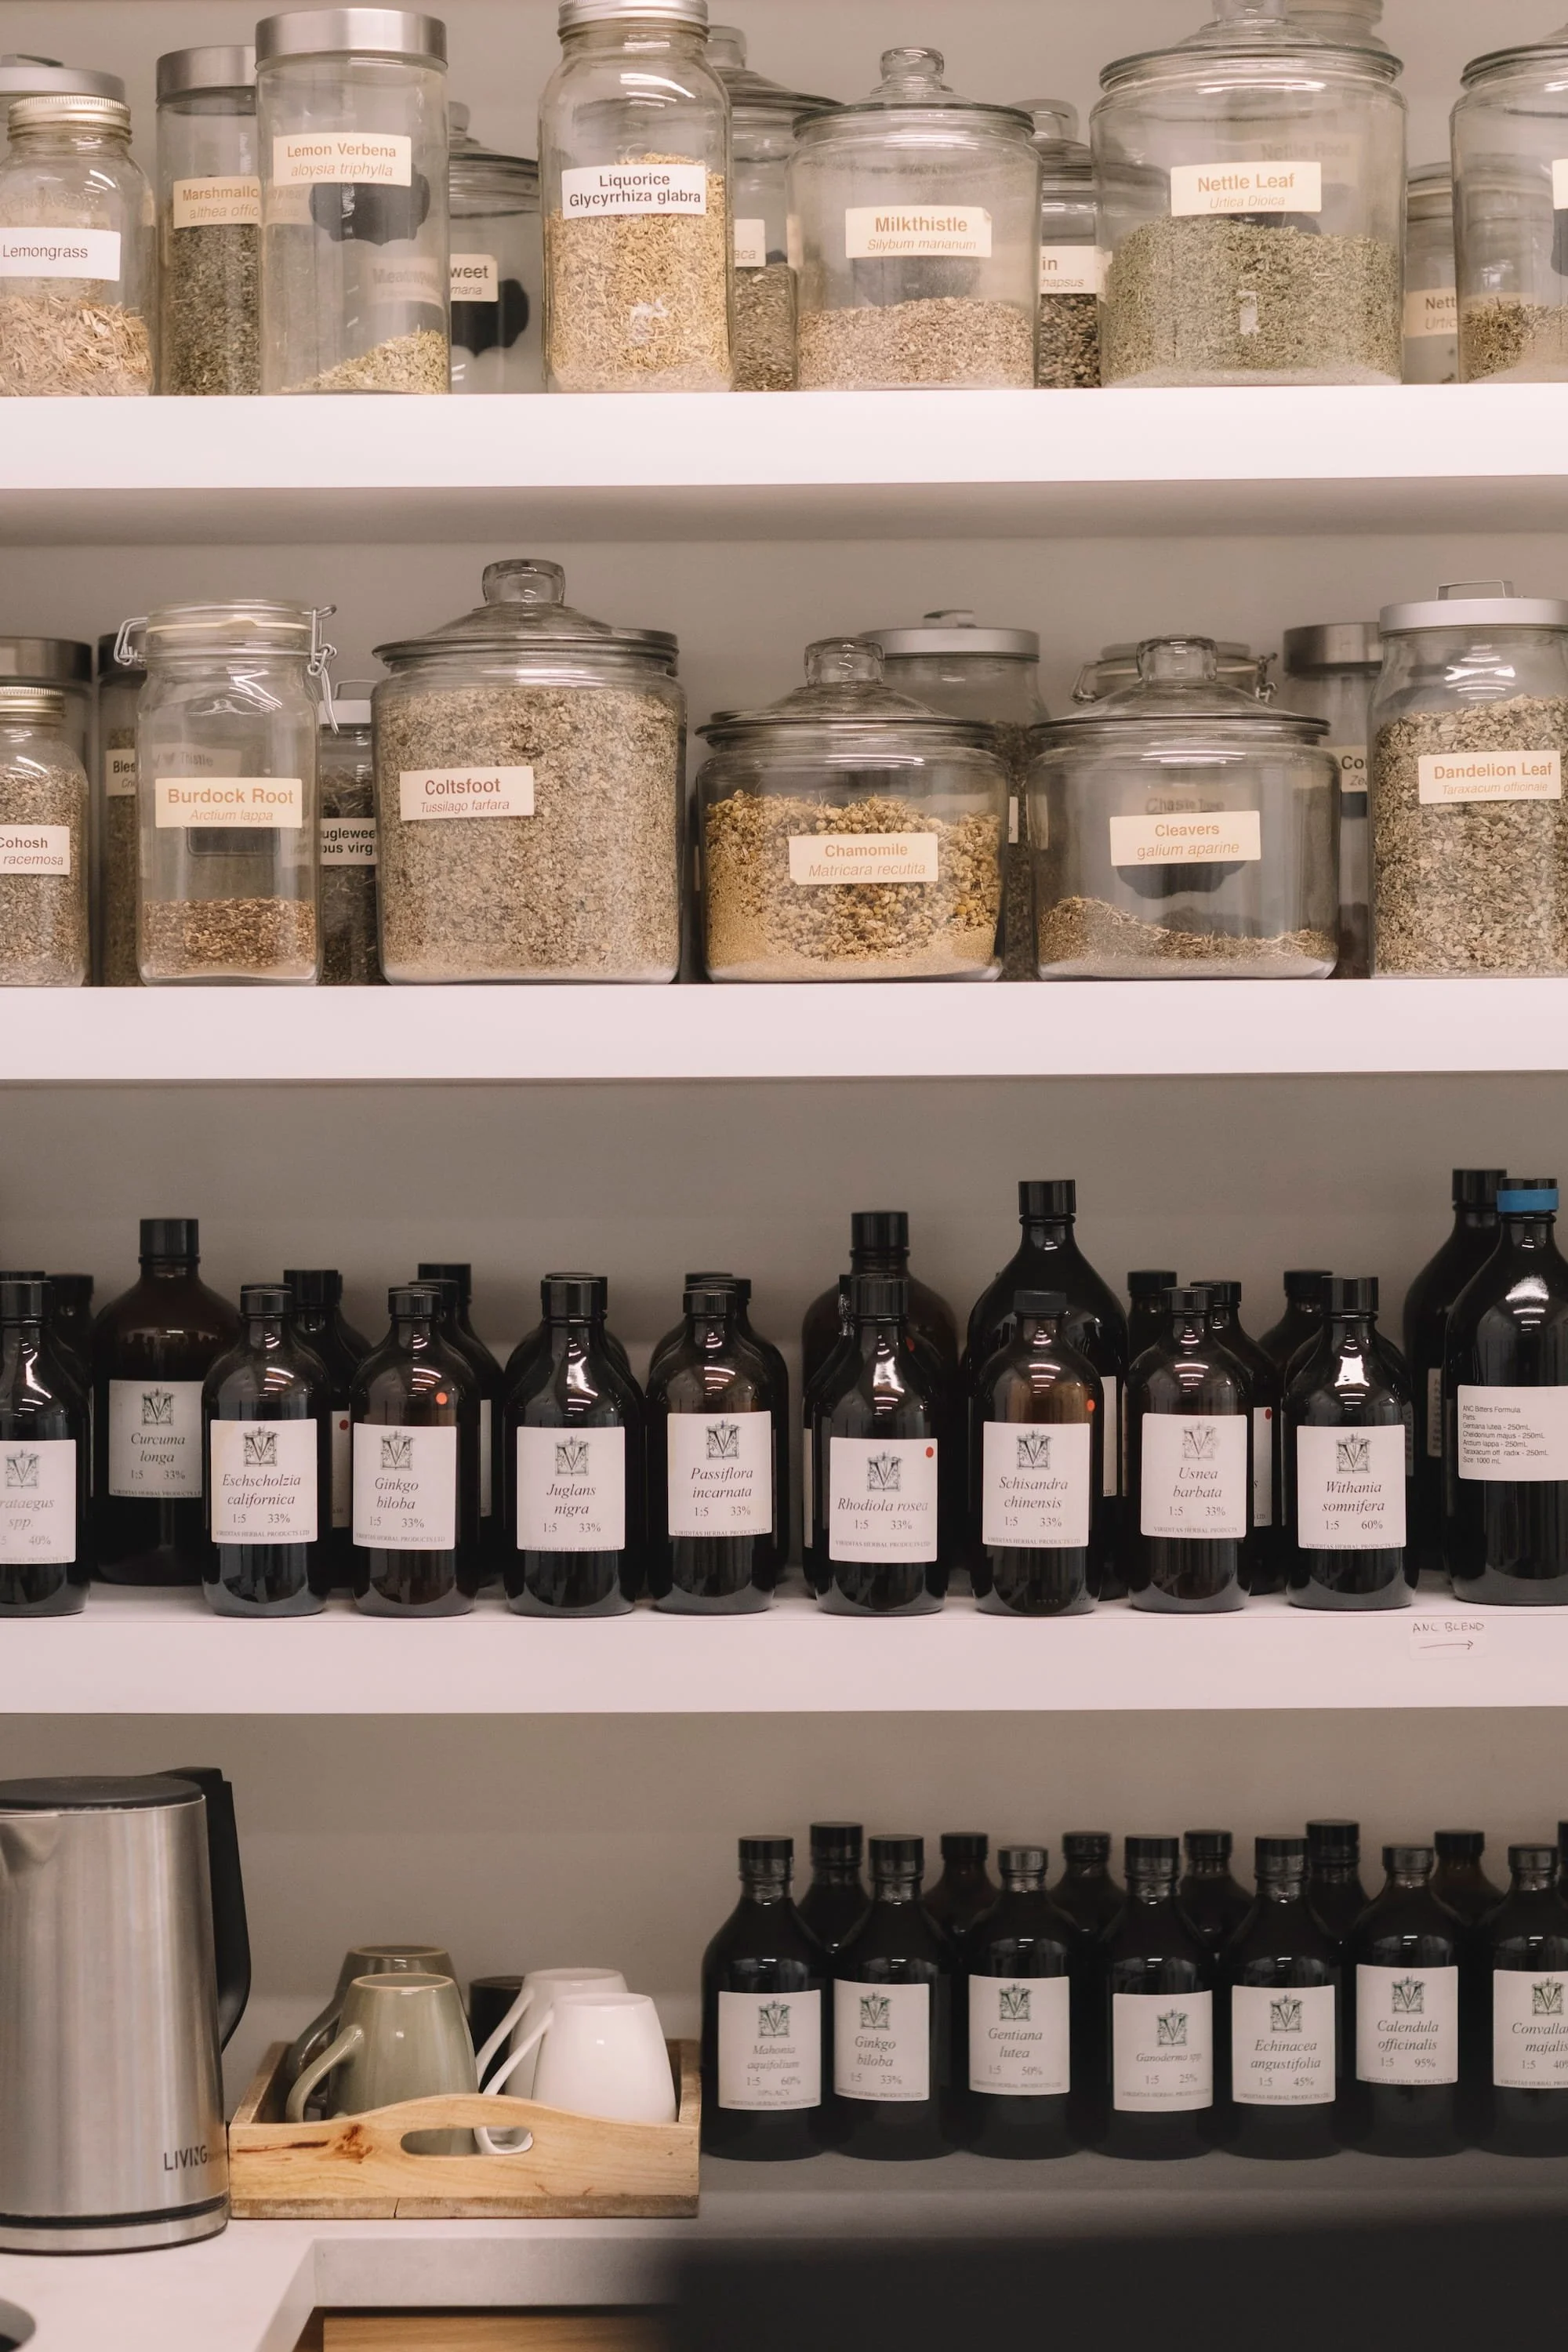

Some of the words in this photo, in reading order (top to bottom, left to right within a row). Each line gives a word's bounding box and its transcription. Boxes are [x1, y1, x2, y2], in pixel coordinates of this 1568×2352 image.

[288, 144, 332, 158] Lemon
[338, 142, 396, 158] Verbena
[291, 162, 335, 177] aloysia
[339, 162, 393, 178] triphylla
[599, 172, 670, 188] Liquorice
[1198, 175, 1250, 193] Nettle
[1256, 172, 1294, 189] Leaf
[569, 191, 652, 208] Glycyrrhiza
[657, 189, 701, 205] glabra
[1210, 196, 1244, 209] Urtica
[1247, 194, 1286, 207] Dioica
[190, 205, 227, 220] althea
[875, 216, 967, 232] Milkthistle
[867, 238, 913, 253] Silybum
[918, 239, 977, 251] marianum
[2, 245, 89, 261] Lemongrass
[1435, 764, 1516, 780] Dandelion
[1521, 762, 1552, 777] Leaf
[425, 778, 501, 797] Coltsfoot
[1442, 784, 1501, 796] Taraxacum
[1504, 782, 1548, 793] officinale
[168, 788, 245, 804] Burdock
[252, 788, 293, 804] Root
[420, 797, 469, 814] Tussilago
[471, 797, 510, 811] farfara
[189, 809, 236, 821] Arctium
[240, 809, 274, 822] lappa
[1155, 824, 1220, 837] Cleavers
[824, 844, 908, 858] Chamomile
[1137, 844, 1183, 860] galium
[1188, 841, 1240, 857] aparine
[3, 855, 64, 866] racemosa
[808, 862, 872, 877] Matricara
[877, 862, 926, 875] recutita
[130, 1432, 186, 1446] Curcuma
[140, 1450, 175, 1465] longa
[163, 1470, 186, 1480] 33%
[222, 1473, 301, 1487] Eschscholzia
[690, 1467, 753, 1482] Passiflora
[1178, 1467, 1218, 1479] Usnea
[375, 1477, 419, 1494] Ginkgo
[999, 1476, 1069, 1490] Schisandra
[1326, 1480, 1382, 1494] Withania
[546, 1483, 597, 1499] Juglans
[692, 1486, 752, 1499] incarnata
[1173, 1485, 1222, 1498] barbata
[227, 1494, 296, 1508] californica
[376, 1496, 416, 1510] biloba
[837, 1497, 894, 1512] Rhodiola
[897, 1501, 928, 1512] rosea
[1004, 1496, 1062, 1509] chinensis
[1322, 1499, 1385, 1515] somnifera
[554, 1503, 590, 1518] nigra
[694, 1507, 709, 1517] 1:5
[731, 1506, 751, 1516] 33%
[1169, 1506, 1183, 1516] 1:5
[1205, 1506, 1226, 1516] 33%
[233, 1514, 246, 1523] 1:5
[267, 1513, 291, 1523] 33%
[369, 1515, 382, 1526] 1:5
[401, 1518, 425, 1528] 33%
[854, 1519, 869, 1530] 1:5
[891, 1520, 913, 1530] 33%
[1004, 1516, 1018, 1526] 1:5
[1040, 1517, 1062, 1527] 33%
[1325, 1520, 1340, 1530] 1:5
[1361, 1519, 1384, 1530] 60%
[543, 1523, 557, 1533] 1:5
[579, 1523, 601, 1533] 33%
[1413, 1623, 1439, 1633] ANC
[1445, 1621, 1484, 1632] BLEND
[988, 2027, 1043, 2040] Gentiana
[1377, 2020, 1439, 2033] Calendula
[753, 2045, 796, 2055] Mahonia
[855, 2036, 896, 2052] Ginkgo
[1254, 2039, 1317, 2052] Echinacea
[1377, 2038, 1437, 2052] officinalis
[1000, 2046, 1030, 2058] lutea
[857, 2054, 894, 2067] biloba
[1250, 2057, 1321, 2072] angustifolia
[1414, 2058, 1436, 2068] 95%
[1522, 2060, 1536, 2070] 1:5
[1022, 2066, 1043, 2076] 50%
[164, 2144, 208, 2171] LIVING
